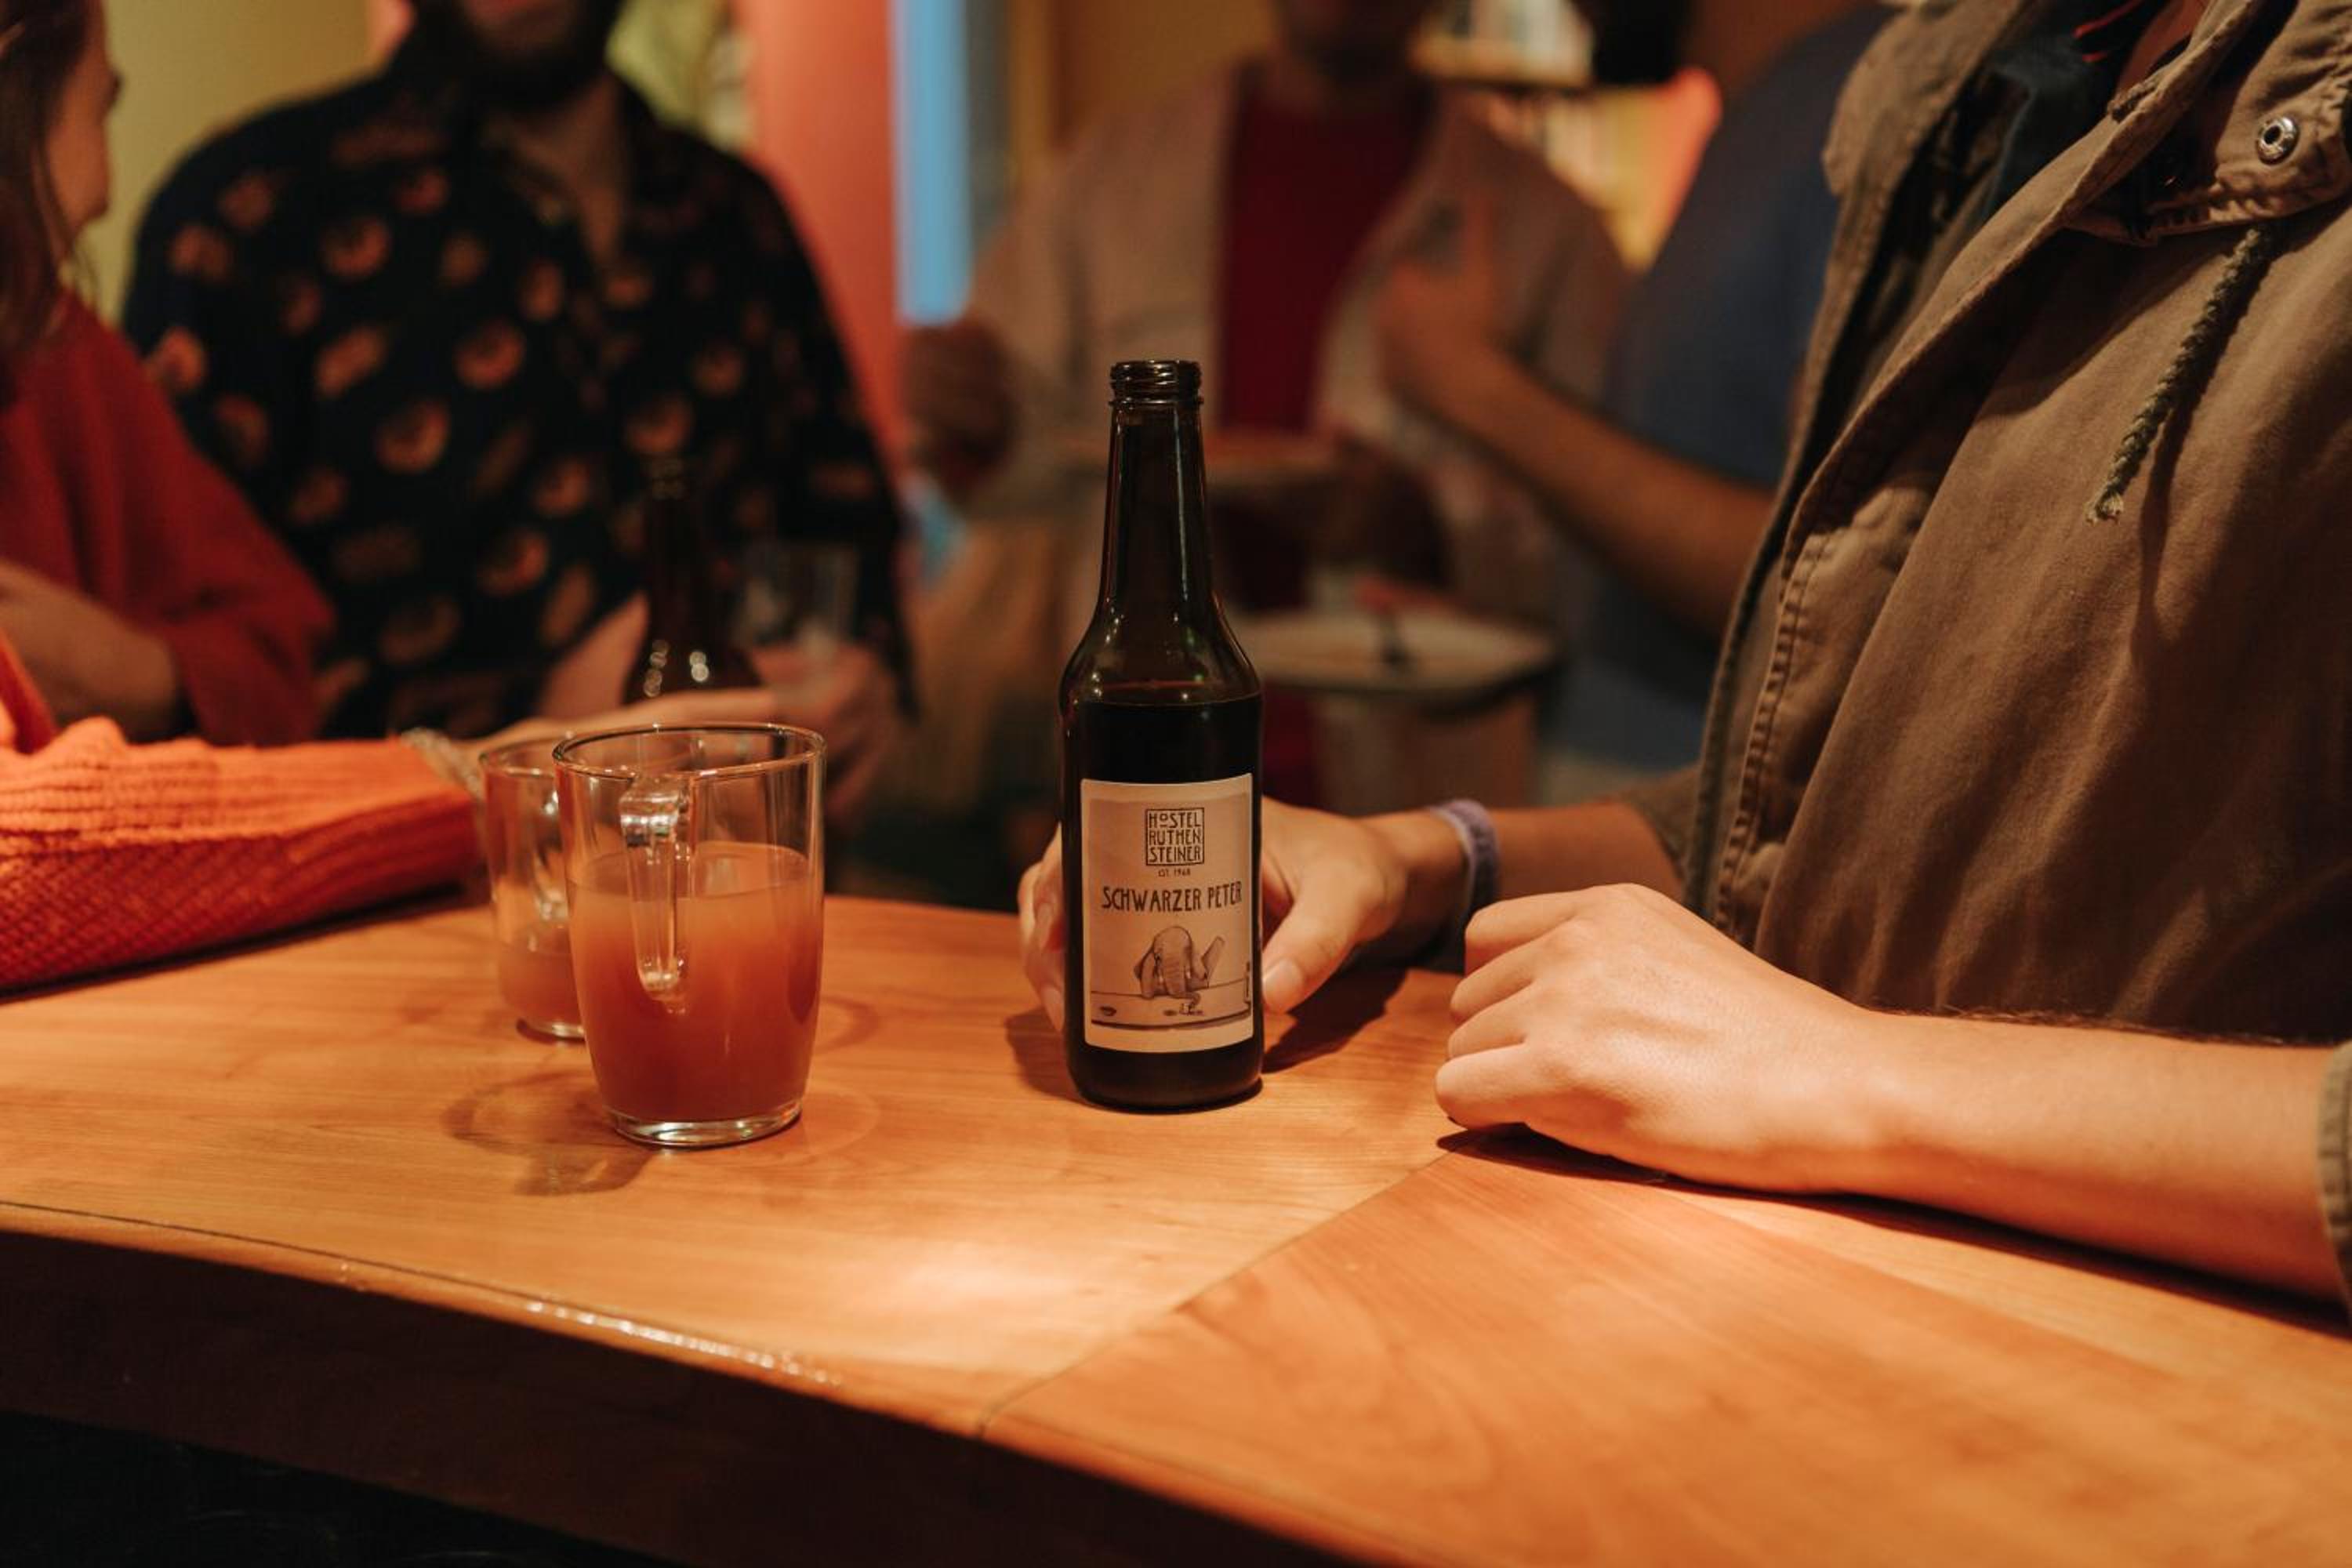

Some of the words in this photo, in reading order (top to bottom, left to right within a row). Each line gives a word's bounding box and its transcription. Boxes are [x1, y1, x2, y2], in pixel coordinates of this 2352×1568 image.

[1149, 811, 1201, 828] HOSTEL
[1149, 829, 1201, 845] RUTHEN
[1149, 846, 1201, 863] STEINER
[1102, 887, 1202, 912] SCHWARZER
[1207, 880, 1242, 909] PETER
